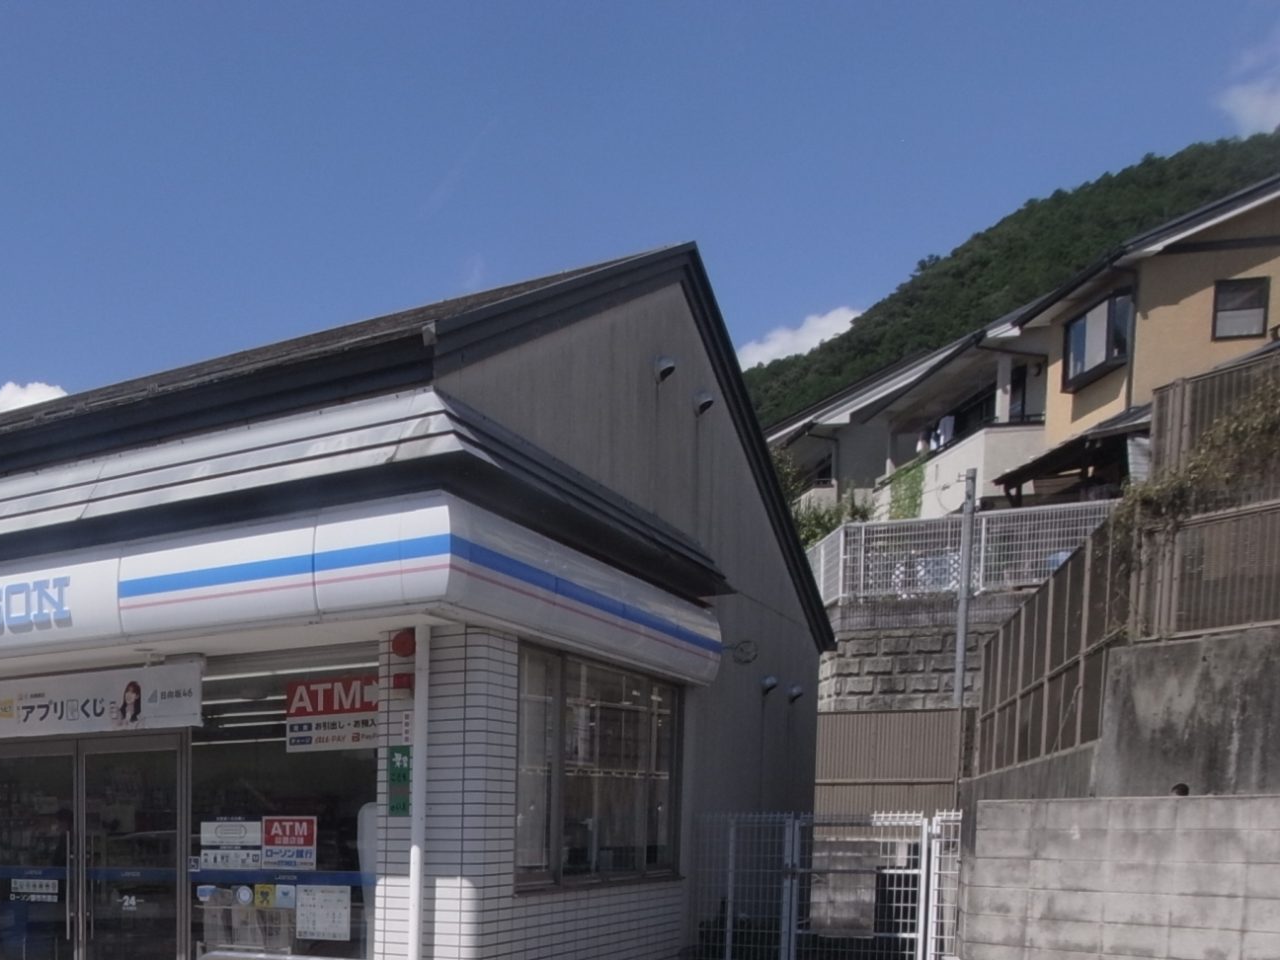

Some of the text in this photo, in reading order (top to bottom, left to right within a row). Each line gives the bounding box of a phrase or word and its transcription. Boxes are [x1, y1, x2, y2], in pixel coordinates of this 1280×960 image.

[290, 681, 362, 714] ATM
[271, 821, 308, 836] ATM
[122, 895, 137, 906] 24
